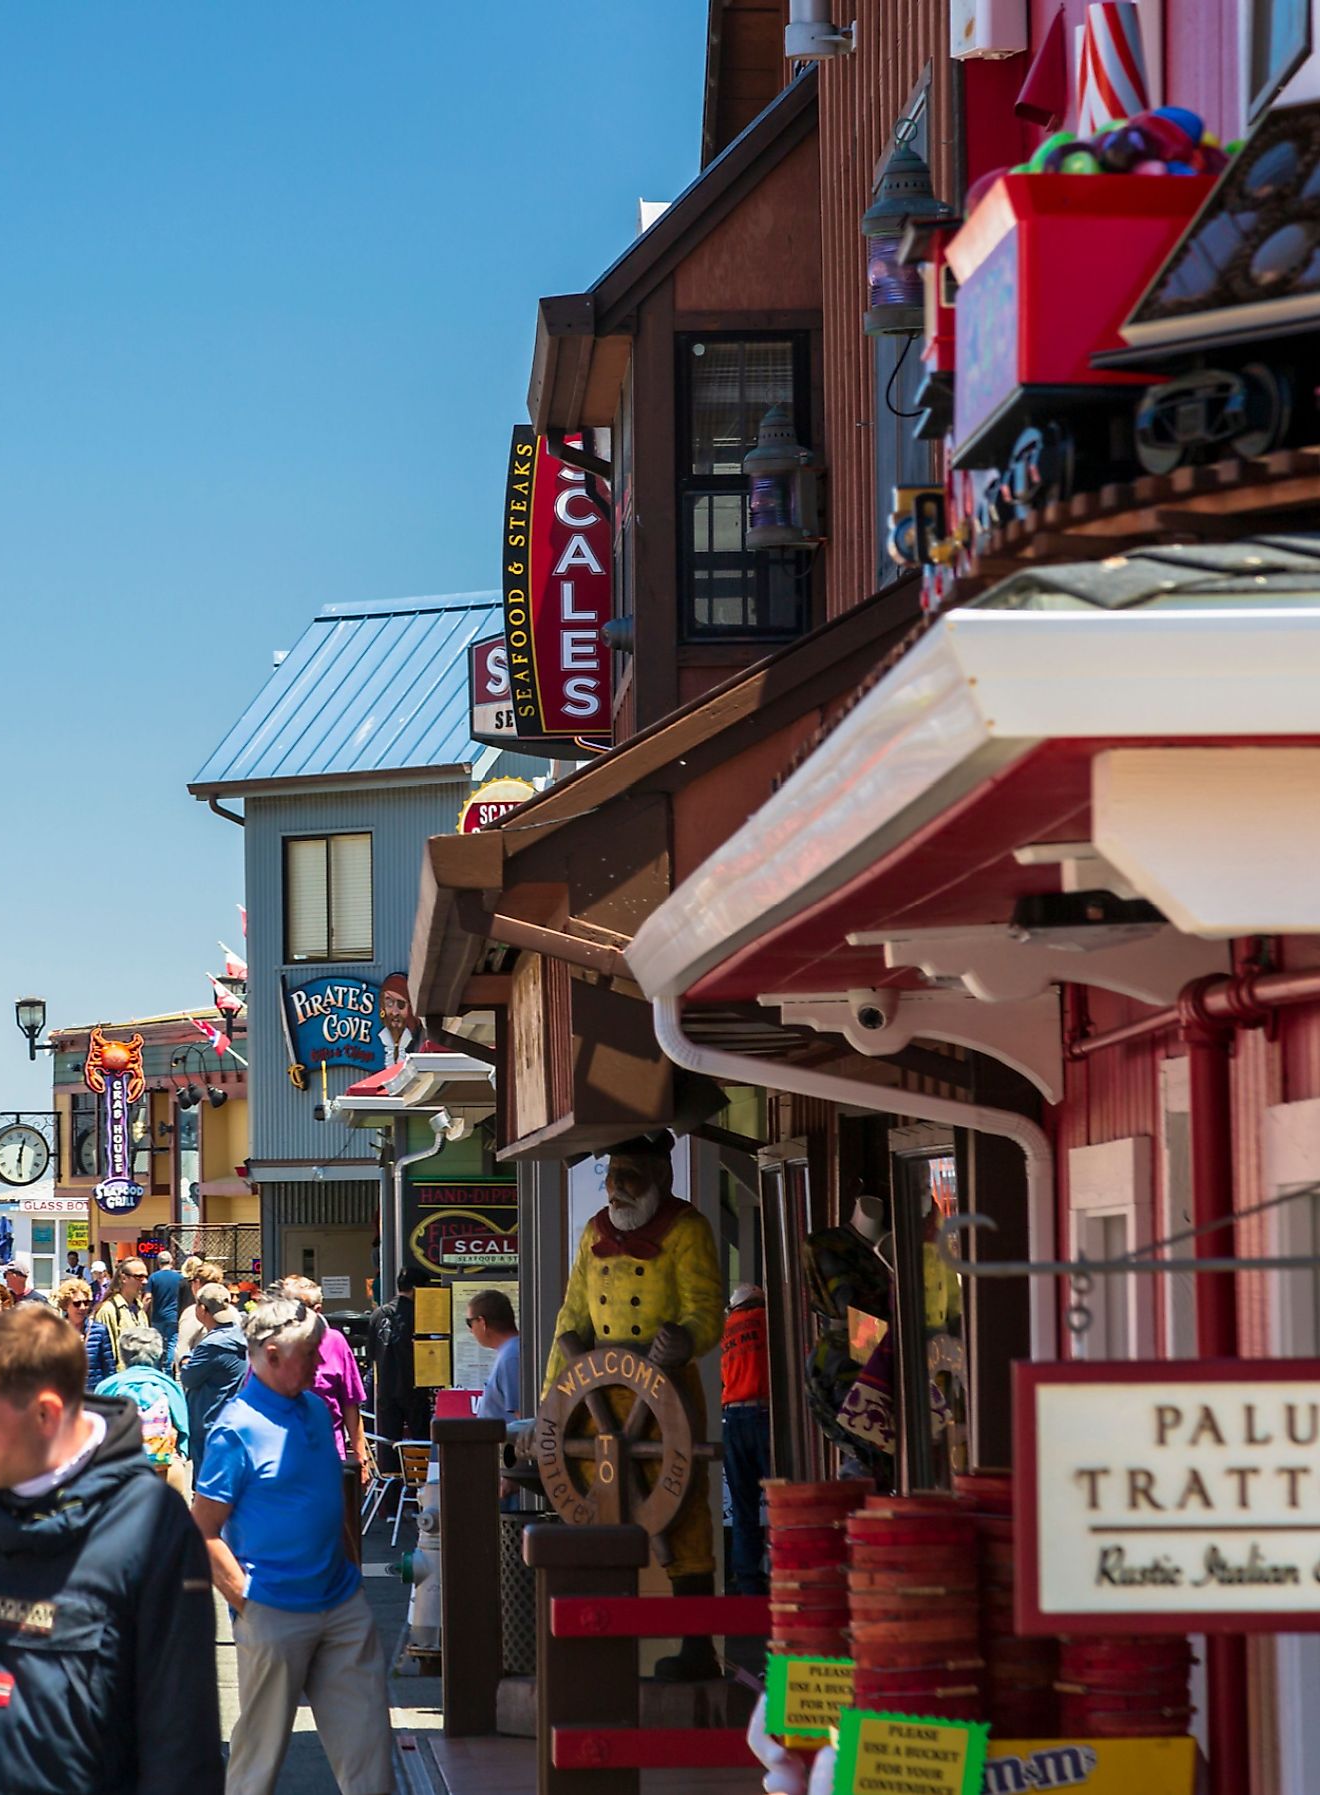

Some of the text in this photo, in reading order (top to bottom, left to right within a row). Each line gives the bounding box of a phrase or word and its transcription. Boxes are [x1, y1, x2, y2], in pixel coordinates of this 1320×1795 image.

[508, 443, 535, 718] SEAFOOD & STEAKS
[290, 982, 375, 1025] PIRATE'S
[322, 1014, 372, 1043] COVE
[112, 1080, 123, 1120] CRAB
[113, 1124, 124, 1173] HOUSE
[25, 1201, 63, 1211] GLASS
[106, 1196, 136, 1209] GRILL
[454, 1240, 515, 1253] SCAL
[557, 1351, 666, 1400] WELCOME
[1154, 1402, 1320, 1447] PALU
[598, 1434, 614, 1483] TO
[1073, 1466, 1313, 1511] TRATT
[863, 1742, 960, 1764] USE A BUCKET
[888, 1725, 939, 1742] PLEASE
[875, 1762, 944, 1781] FOR YOUR
